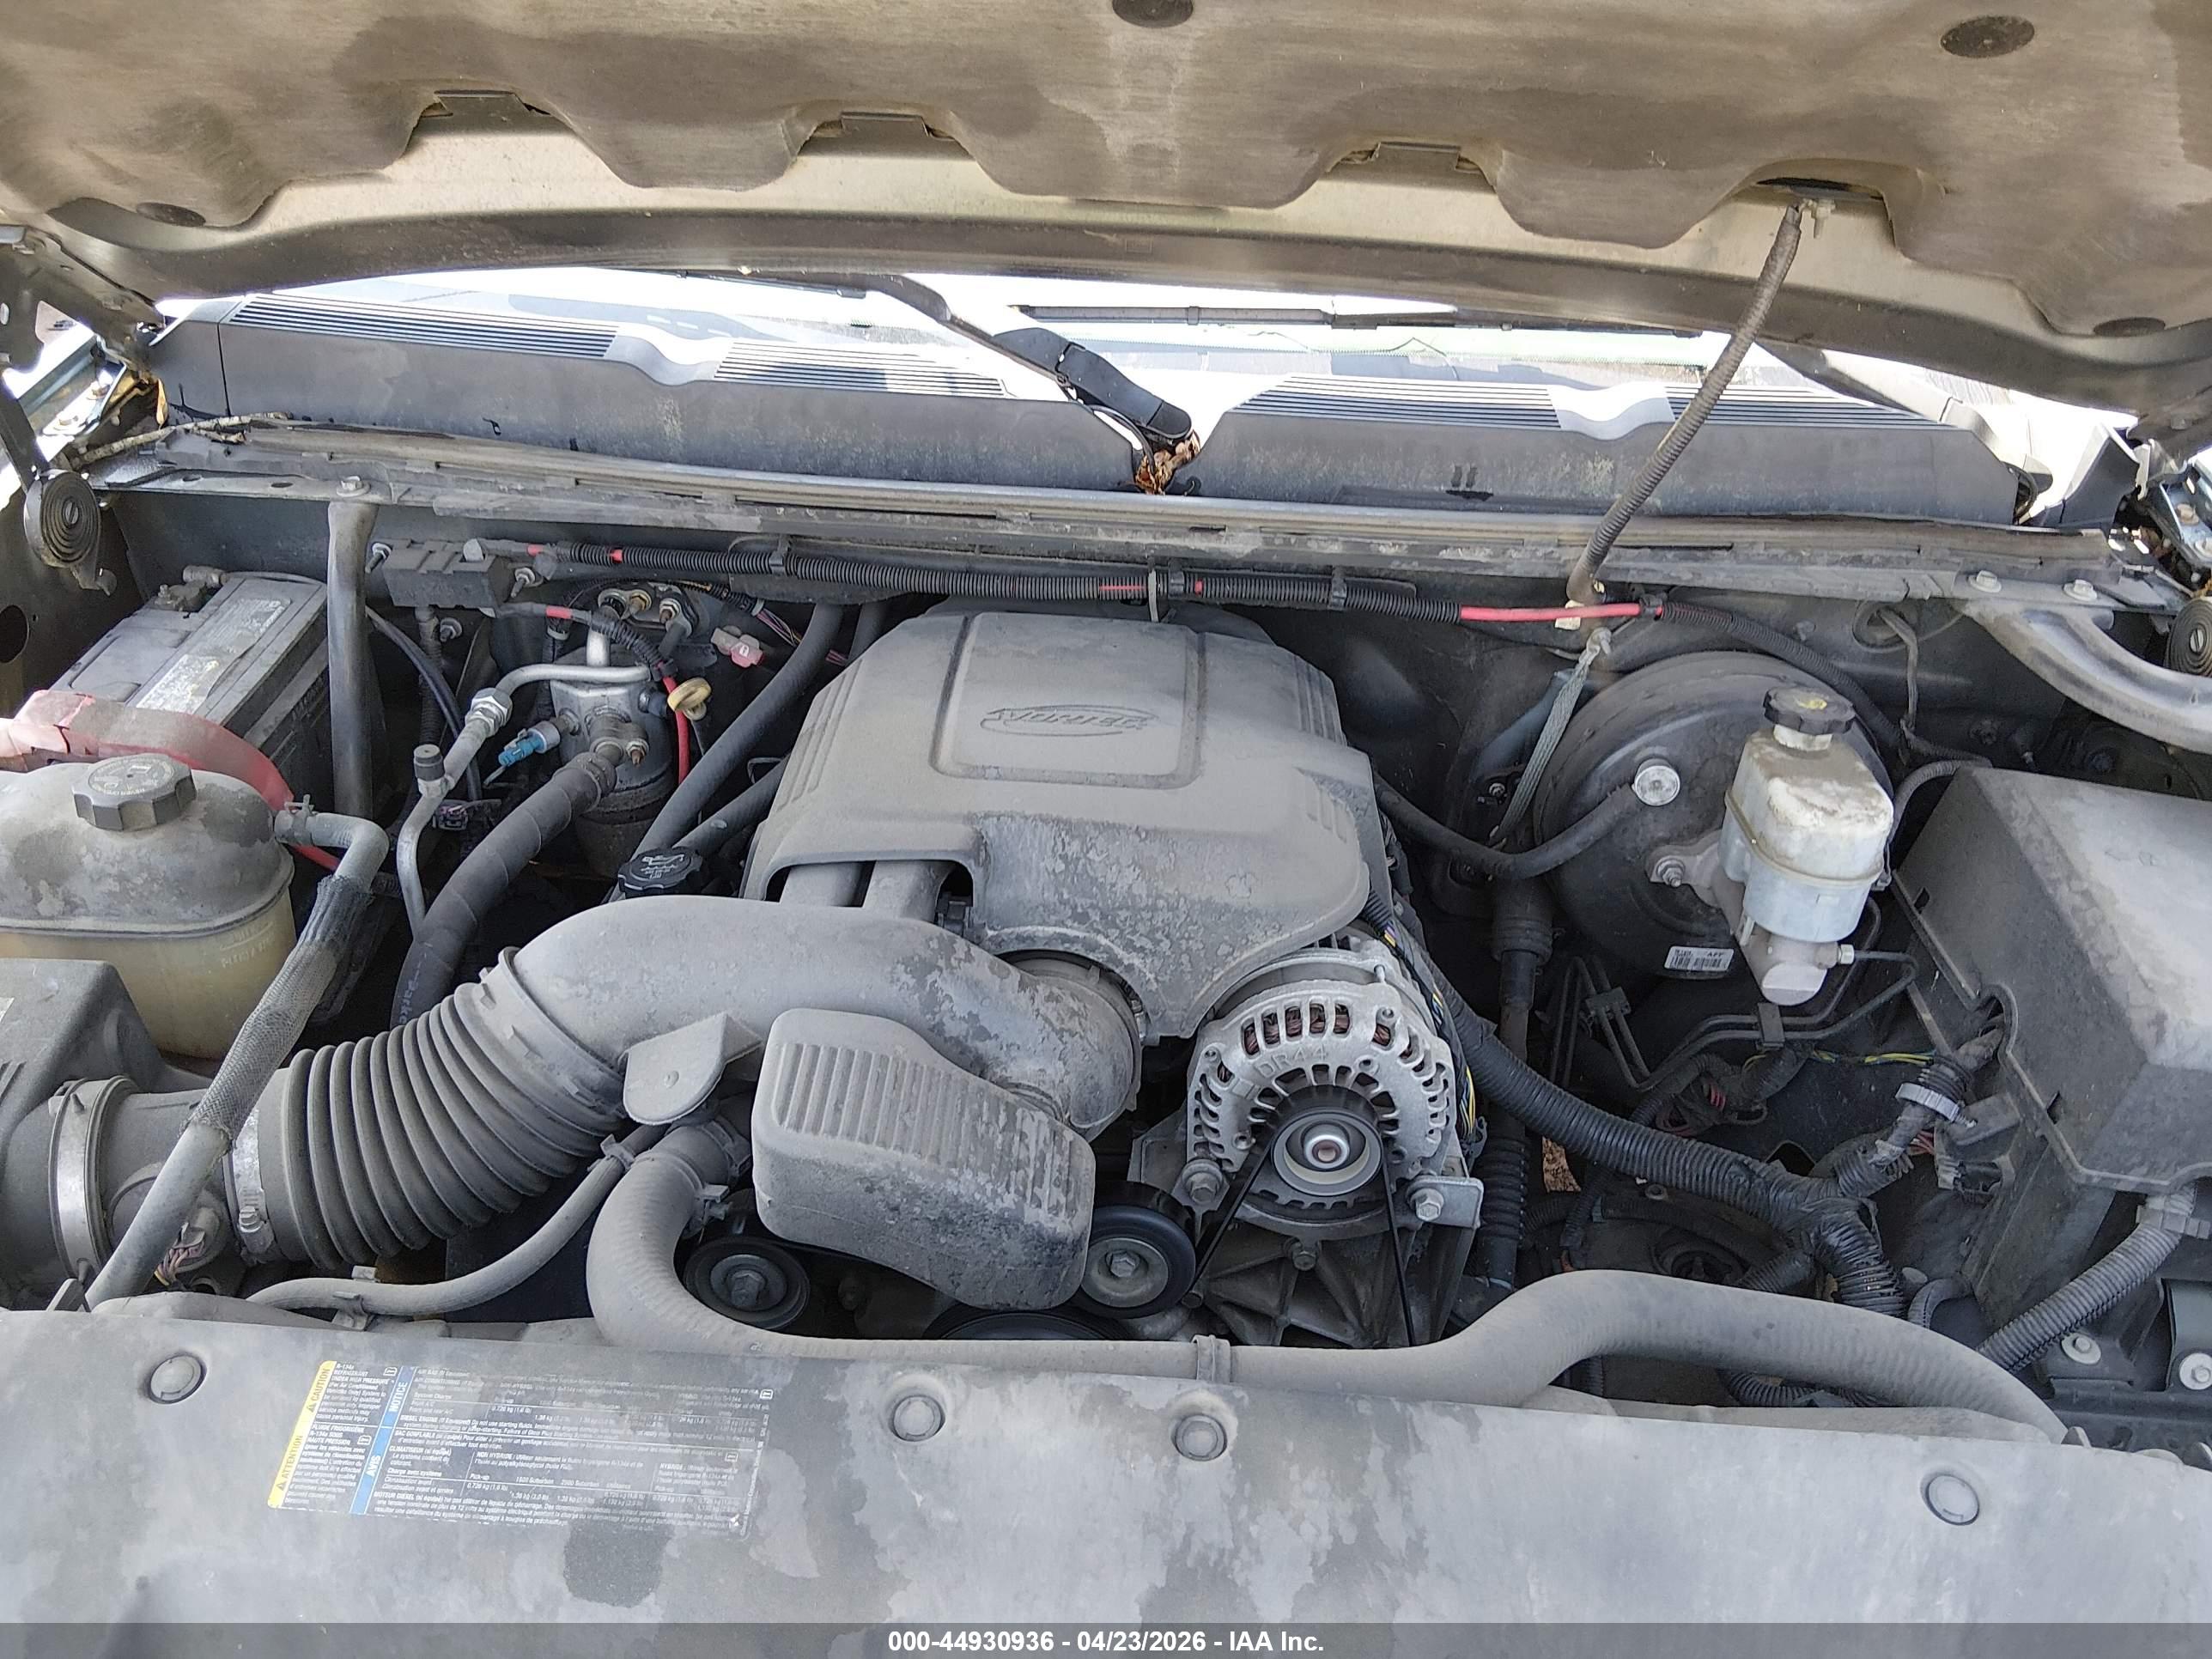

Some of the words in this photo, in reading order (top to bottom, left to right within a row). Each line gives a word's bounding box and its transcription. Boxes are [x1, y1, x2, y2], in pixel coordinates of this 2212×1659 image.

[313, 1368, 331, 1402] CAUTION
[388, 1381, 408, 1413] NOTICE
[281, 1435, 304, 1479] ATTENTION
[364, 1455, 381, 1478] AVIS
